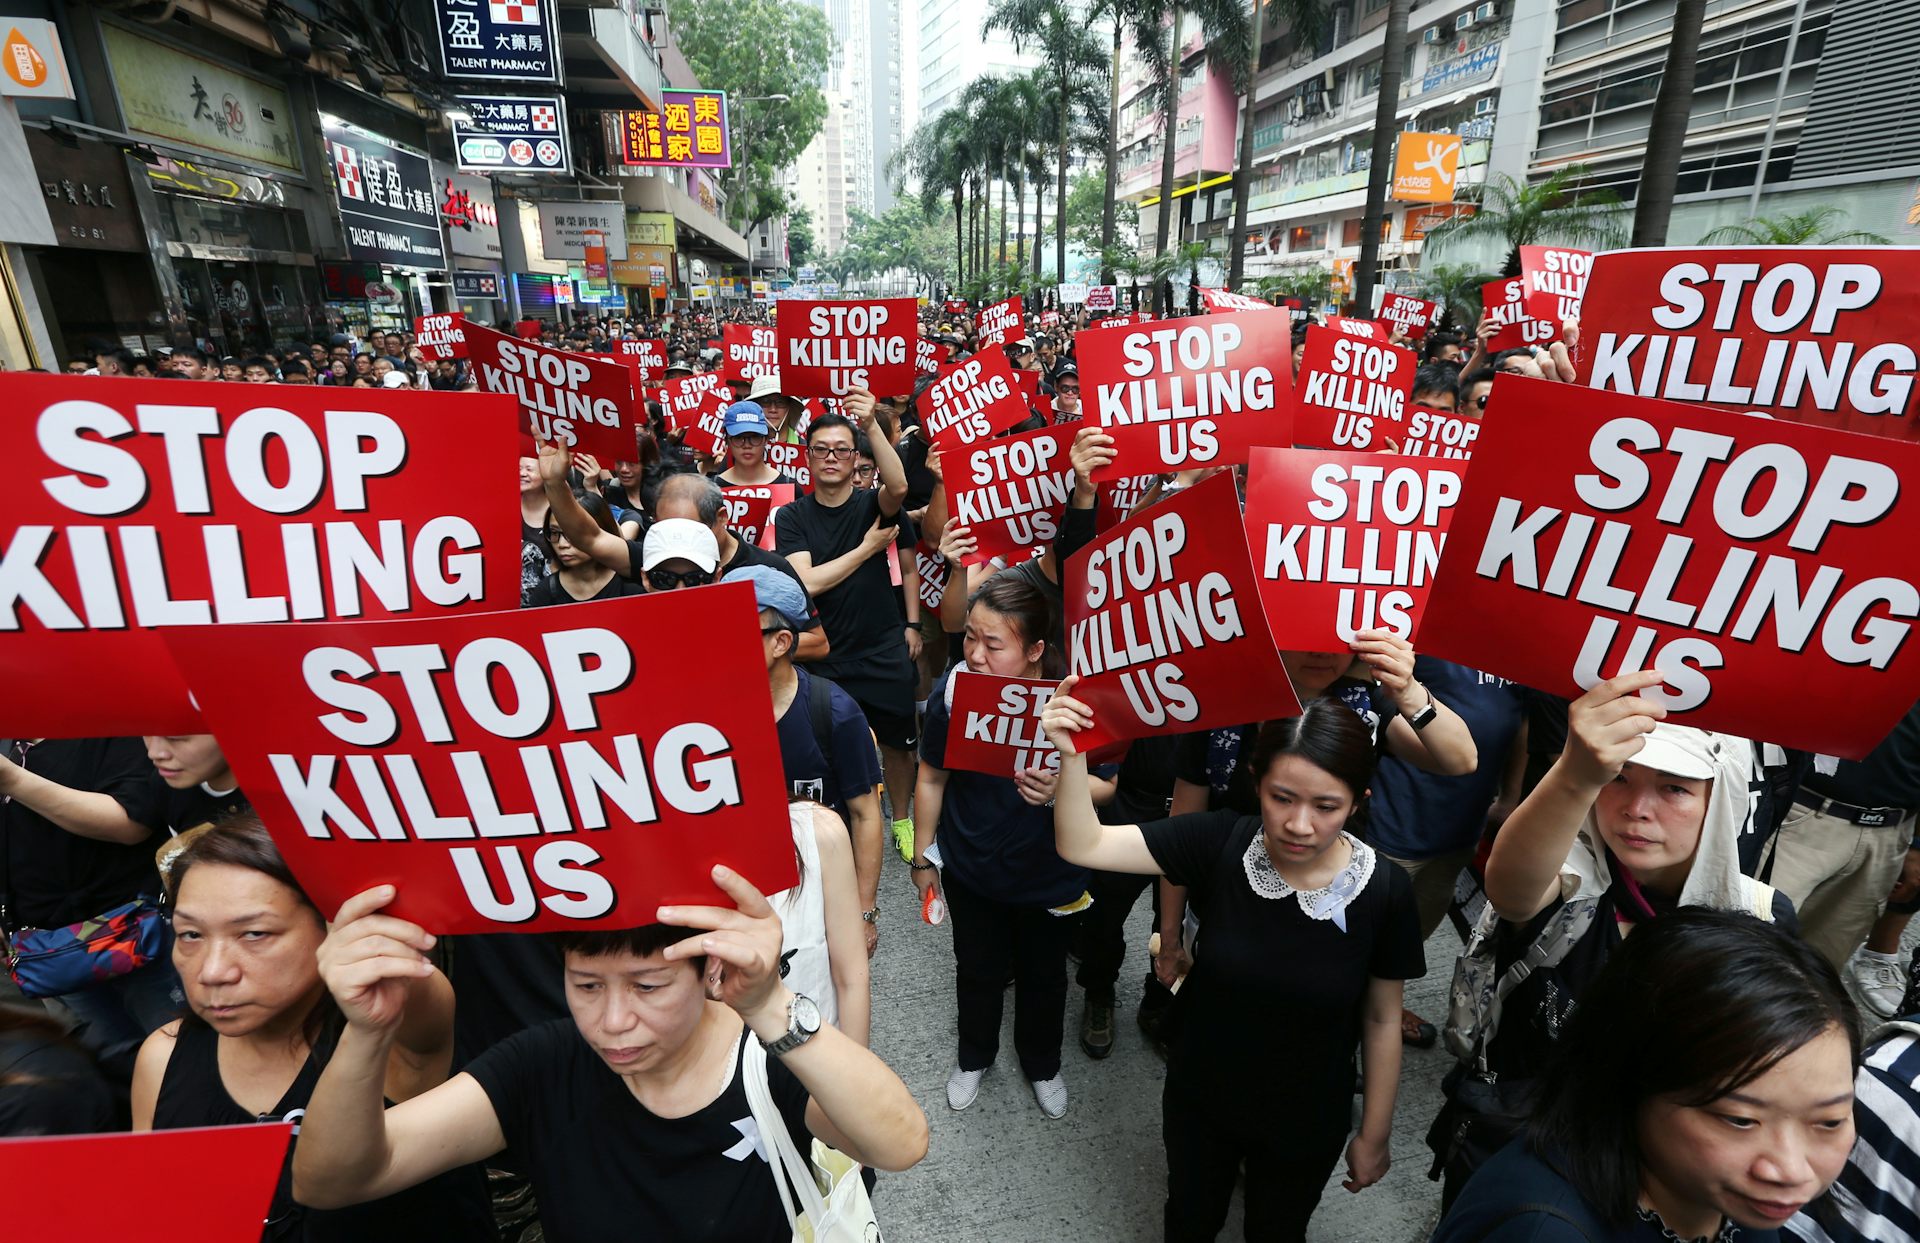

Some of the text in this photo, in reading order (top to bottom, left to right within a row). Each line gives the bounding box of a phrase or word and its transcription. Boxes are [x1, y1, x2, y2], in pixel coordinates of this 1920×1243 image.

[447, 0, 485, 50] 盈
[494, 33, 544, 52] 大藥房
[450, 57, 546, 71] TALENT PHARMACY
[457, 103, 528, 120] 大藥房
[664, 103, 693, 161] 酒家
[693, 95, 722, 153] 東園
[349, 226, 377, 248] TALENT
[376, 230, 412, 252] PHARMACY
[982, 302, 1010, 323] STOP
[1382, 308, 1427, 329] KILLING
[1393, 297, 1424, 314] STOP
[1651, 262, 1882, 334] STOP
[418, 329, 465, 347] KILLING
[423, 315, 452, 332] STOP
[752, 329, 775, 347] US
[809, 305, 889, 337] STOP
[978, 313, 1019, 340] KILLING
[1340, 319, 1374, 339] STOP
[1522, 320, 1554, 342] US
[435, 345, 455, 358] US
[496, 339, 591, 391] STOP
[622, 342, 653, 355] STOP
[789, 336, 906, 368] KILLING
[1122, 323, 1242, 377] STOP
[1331, 338, 1398, 383] STOP
[680, 374, 718, 395] STOP
[830, 368, 870, 396] US
[930, 360, 982, 408] STOP
[1589, 333, 1917, 415] KILLING
[482, 363, 620, 429] KILLING
[673, 386, 733, 411] KILNG
[926, 375, 1010, 438] KILLING
[1097, 366, 1275, 428] KILLING
[1303, 370, 1405, 422] KILLING
[529, 409, 578, 448] US
[955, 412, 991, 445] US
[1158, 419, 1220, 466] US
[1332, 412, 1375, 449] US
[1407, 411, 1481, 448] STOP
[36, 399, 407, 516] STOP
[970, 435, 1058, 486] STOP
[1307, 463, 1463, 527] STOP
[1574, 416, 1900, 552] STOP
[1005, 511, 1058, 545] US
[0, 515, 484, 631] KILLING
[1087, 512, 1186, 609] STOP
[919, 581, 943, 609] US
[1476, 496, 1920, 670] KILLING
[1071, 571, 1245, 677] KILLING
[1336, 588, 1415, 645] US
[1572, 614, 1724, 712] US
[301, 627, 633, 747] STOP
[1120, 662, 1199, 727] US
[267, 722, 742, 842] KILLING
[1014, 748, 1061, 775] US
[1860, 813, 1884, 822] Levi's
[449, 839, 616, 924] US
